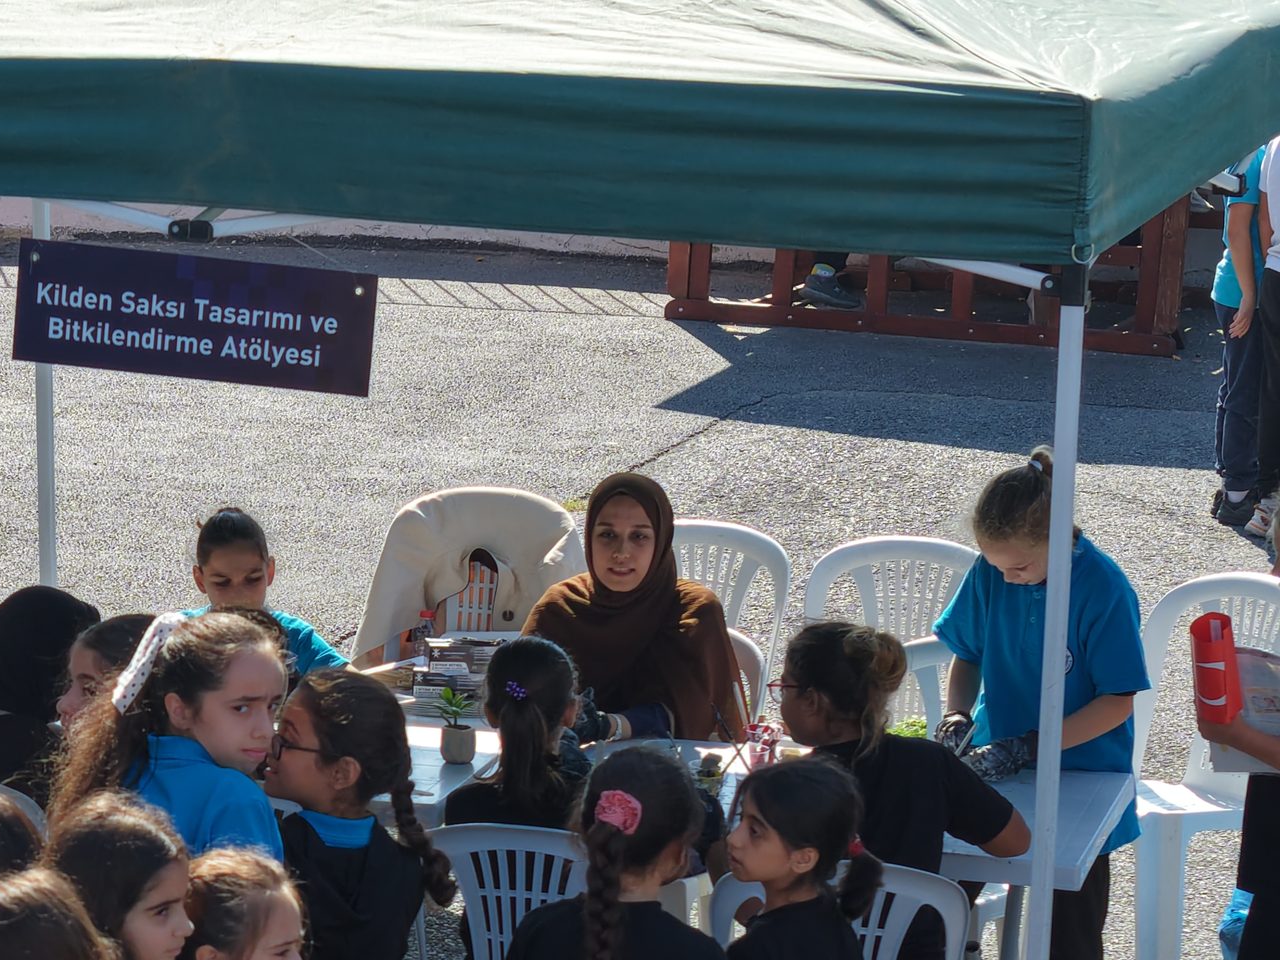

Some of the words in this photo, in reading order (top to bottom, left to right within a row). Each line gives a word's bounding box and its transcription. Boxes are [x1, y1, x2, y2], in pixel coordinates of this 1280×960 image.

[36, 281, 112, 312] Kilden
[120, 290, 185, 320] Saksı
[194, 298, 302, 332] Tasarımı
[310, 314, 339, 335] ve
[48, 316, 213, 356] Bitkilendirme
[220, 335, 322, 368] Atölyesi
